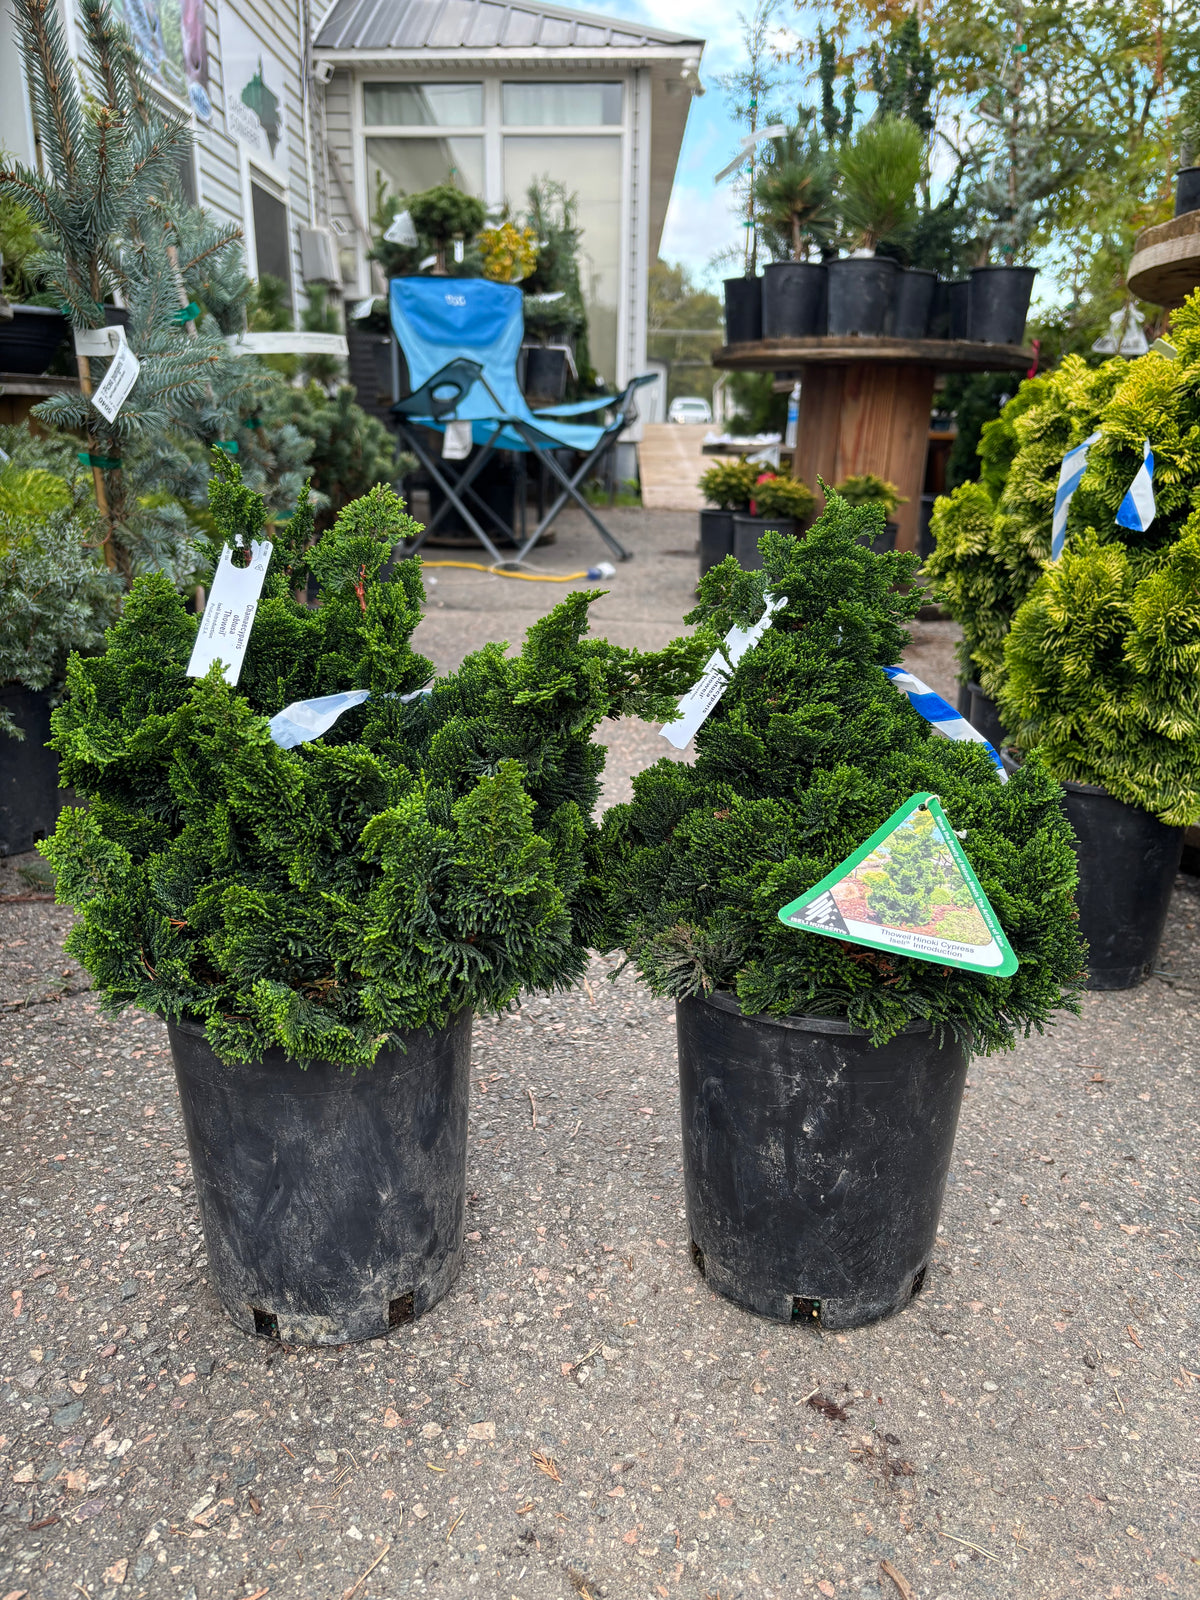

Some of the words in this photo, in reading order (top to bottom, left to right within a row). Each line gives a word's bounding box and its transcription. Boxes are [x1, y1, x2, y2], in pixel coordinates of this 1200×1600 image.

[229, 614, 241, 635] obtusa
[235, 604, 255, 650] Chamaecyparis
[982, 908, 995, 930] Artistry
[881, 928, 912, 941] Thoweil
[913, 935, 938, 946] Hinoki
[940, 942, 975, 954] Cypress
[913, 942, 963, 958] Introduction
